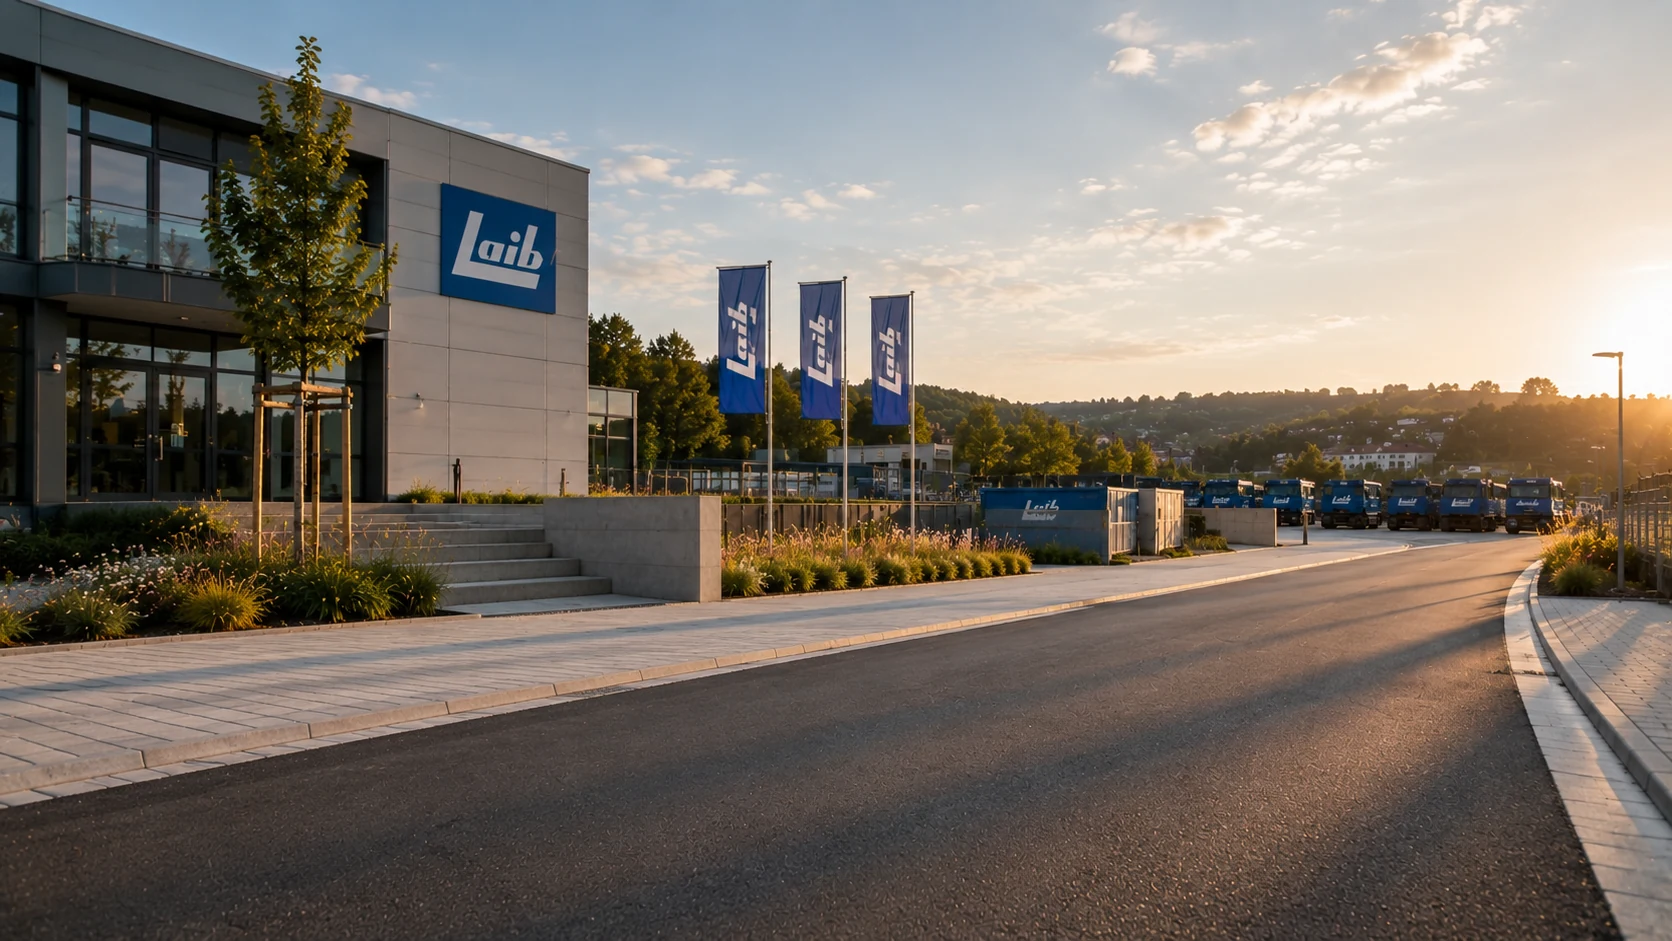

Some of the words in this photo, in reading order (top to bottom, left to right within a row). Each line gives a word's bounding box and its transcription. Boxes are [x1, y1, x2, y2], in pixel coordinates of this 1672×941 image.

[451, 210, 543, 290] Laib
[726, 301, 757, 380] Laib
[807, 314, 834, 387] Laib
[878, 327, 902, 396] Laib
